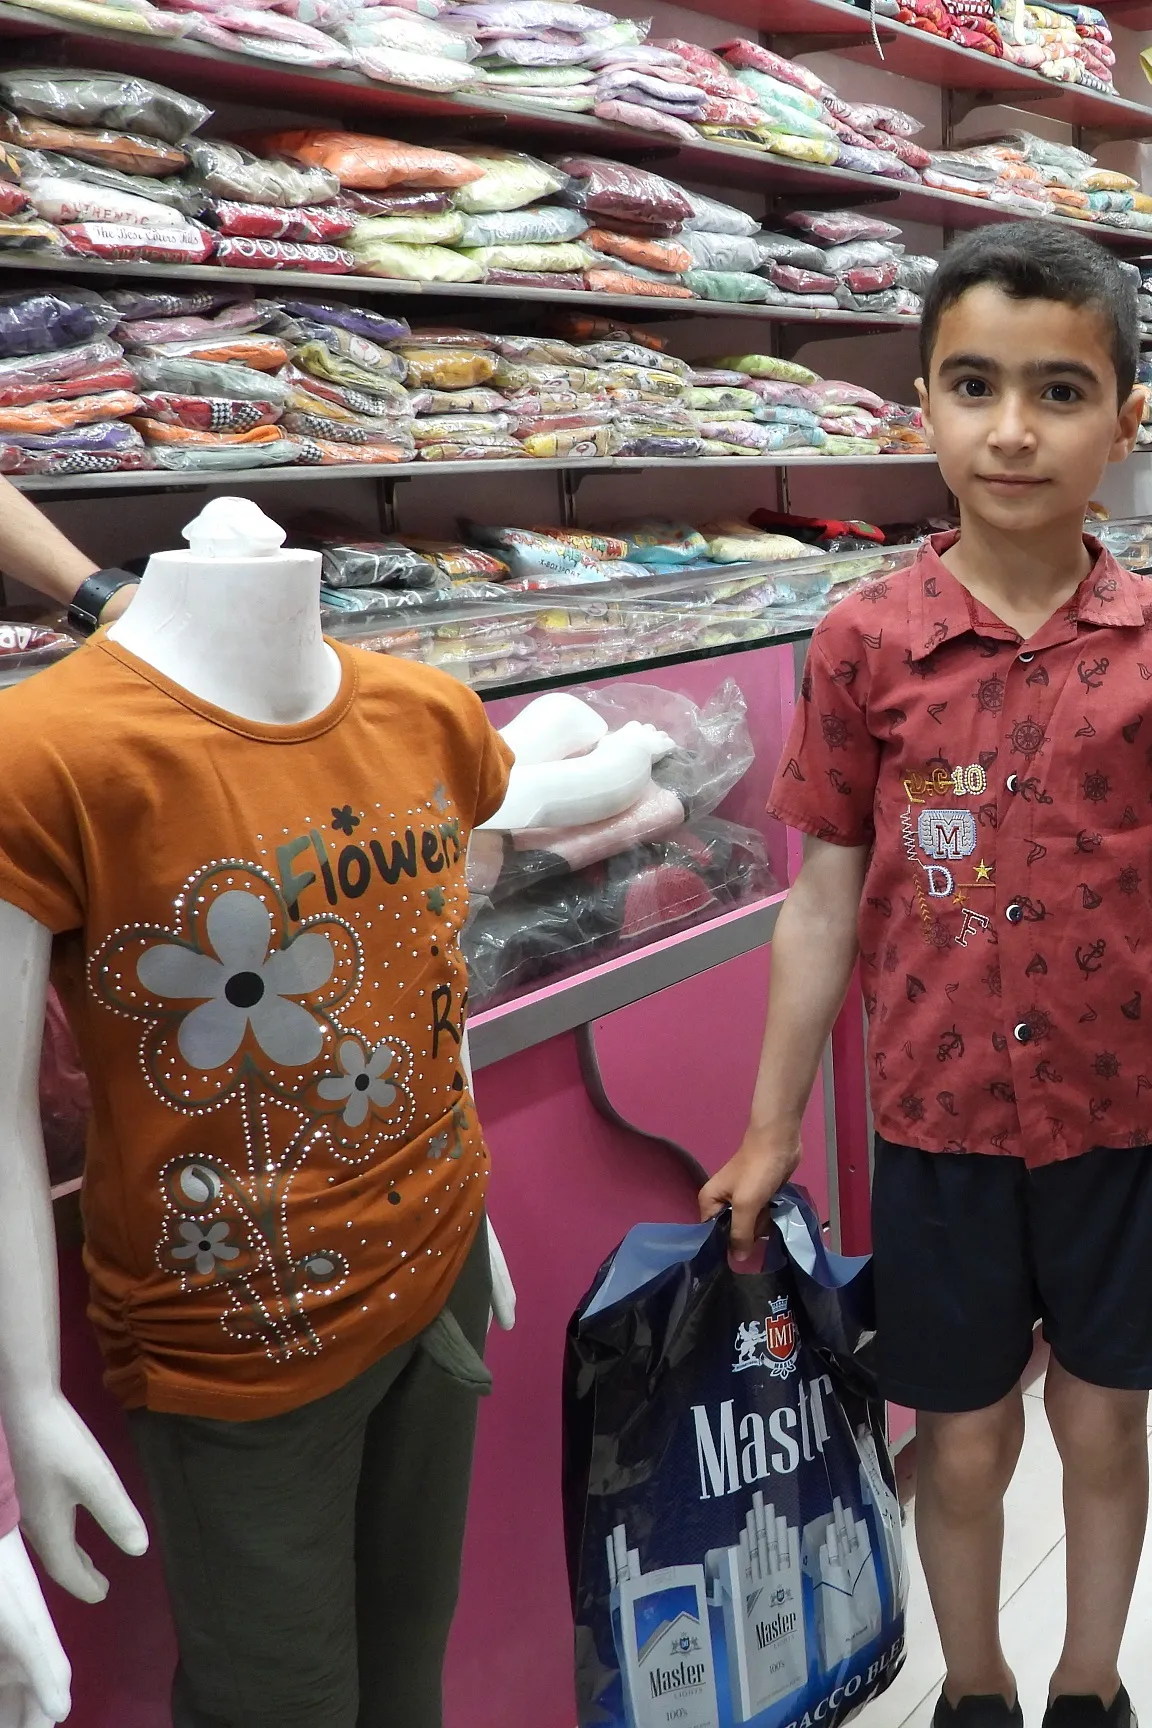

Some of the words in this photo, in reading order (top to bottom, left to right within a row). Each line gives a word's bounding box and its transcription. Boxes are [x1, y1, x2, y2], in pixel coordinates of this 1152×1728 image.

[60, 201, 150, 226] AUTHENTIC
[96, 225, 114, 239] The
[930, 818, 964, 860] M
[923, 864, 955, 898] D
[954, 907, 989, 947] F
[755, 1611, 797, 1651] Master
[866, 1635, 905, 1685] BLE
[649, 1661, 706, 1699] Master
